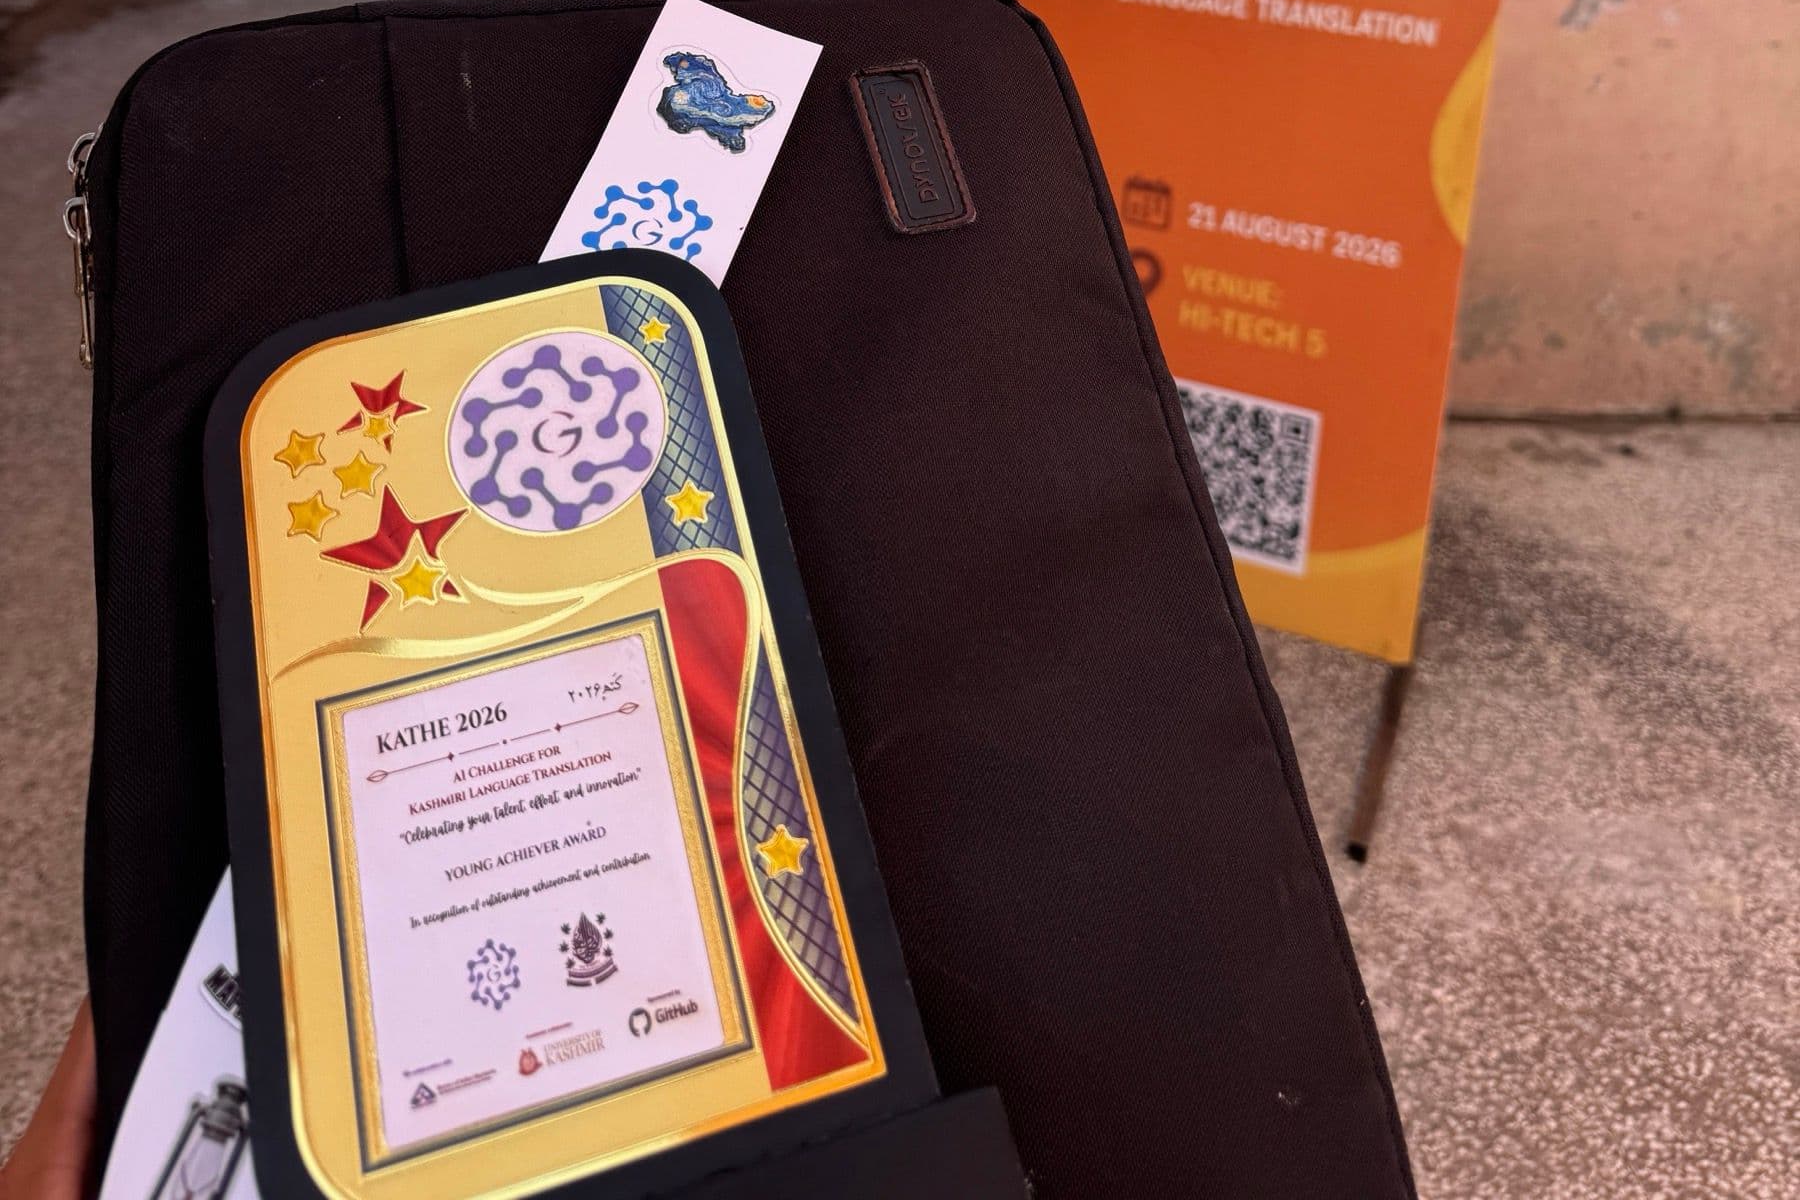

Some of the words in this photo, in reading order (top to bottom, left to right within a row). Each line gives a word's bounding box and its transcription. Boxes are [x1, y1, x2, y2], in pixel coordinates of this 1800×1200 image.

[1187, 202, 1217, 232] 21
[1220, 208, 1328, 252] AUGUST
[1331, 231, 1403, 269] 2026
[1181, 264, 1284, 309] VENUE:
[1178, 301, 1300, 352] HI-TECH
[1305, 327, 1328, 359] 5
[376, 716, 451, 754] KATHE
[455, 701, 508, 733] 2026
[408, 791, 467, 816] KASHMIRI
[469, 773, 531, 799] LANGUAGE
[532, 751, 612, 781] TRANSLATION
[453, 768, 467, 783] AI
[468, 751, 535, 779] CHALLENGE
[538, 745, 562, 761] FOR
[467, 812, 493, 830] your
[563, 783, 585, 800] and
[444, 858, 493, 882] YOUNG
[496, 839, 560, 867] ACHIEVER
[562, 826, 607, 849] AWARD
[409, 916, 421, 929] In
[423, 904, 469, 925] recognition
[470, 898, 480, 911] of
[481, 886, 530, 907] outstanding
[532, 868, 582, 893] achievement
[583, 864, 600, 879] and
[601, 852, 651, 874] contribution
[655, 999, 699, 1024] GitHub
[544, 1038, 606, 1066] KASHMIR
